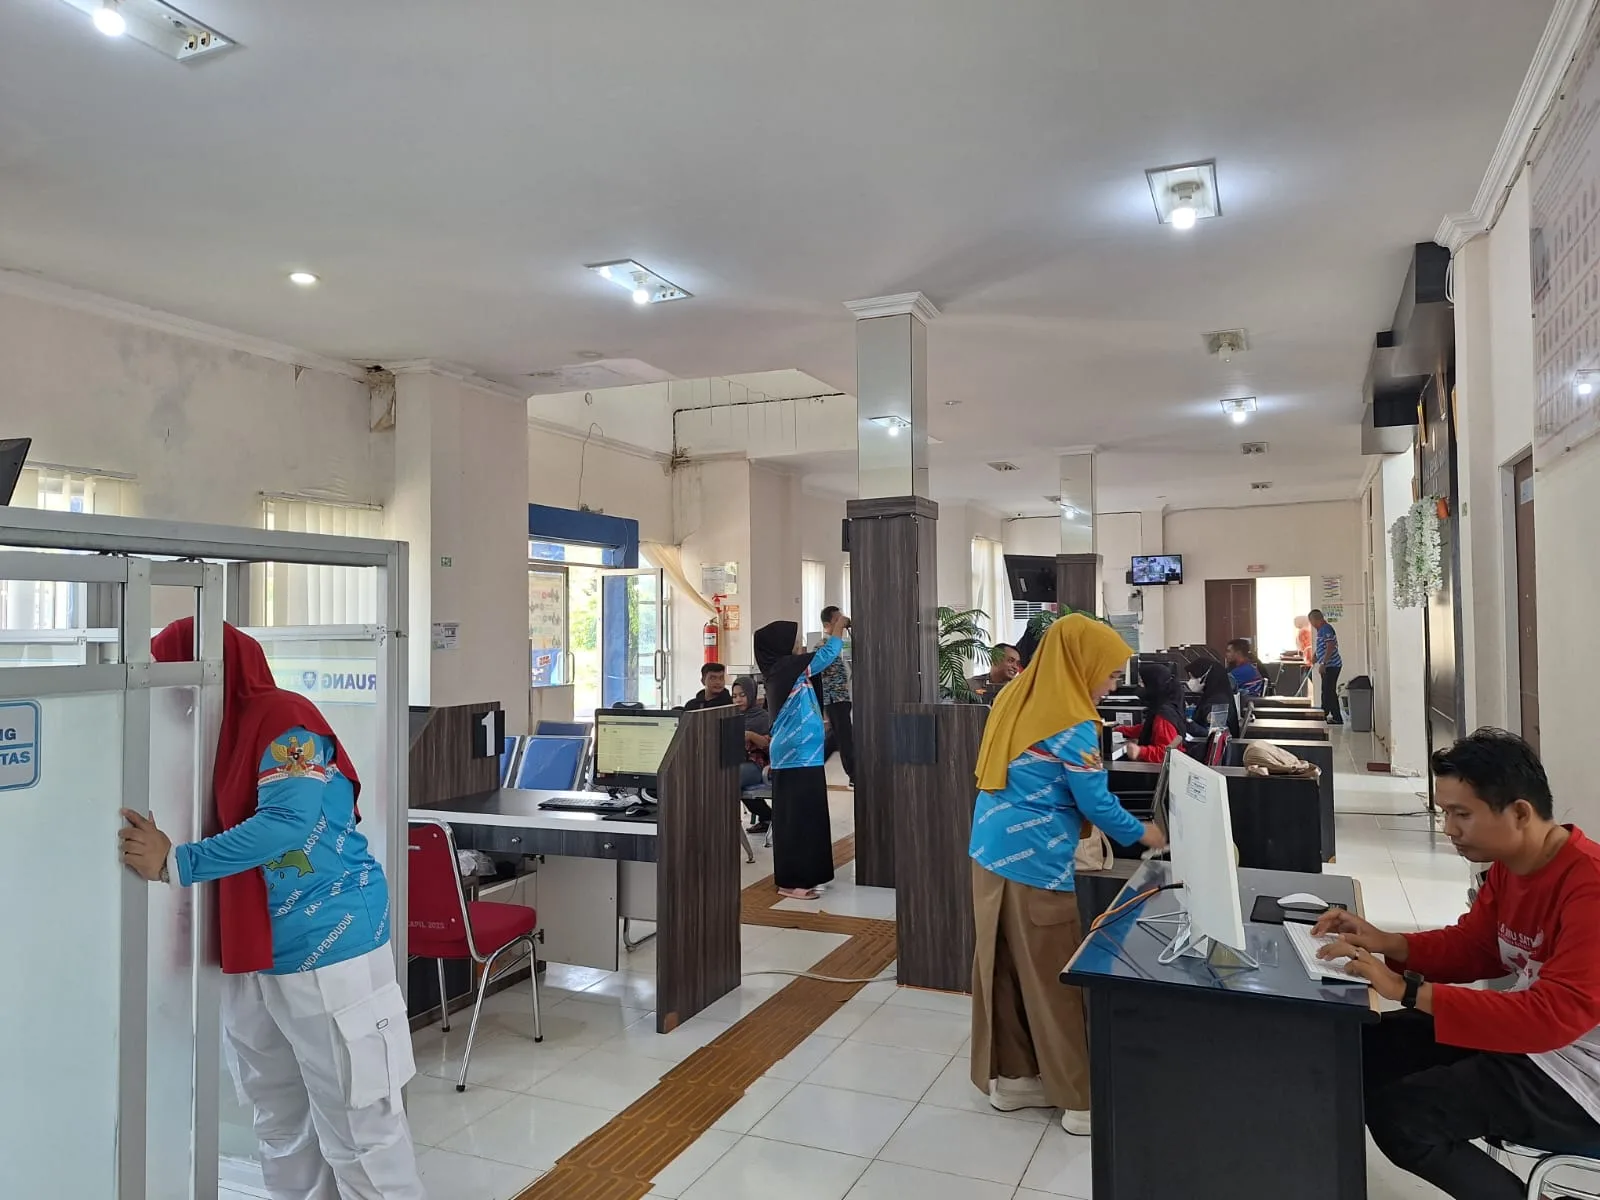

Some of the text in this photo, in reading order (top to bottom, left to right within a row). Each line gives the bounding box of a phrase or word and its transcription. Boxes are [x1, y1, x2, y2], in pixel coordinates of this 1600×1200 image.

[0, 728, 17, 742] G
[482, 711, 495, 757] 1
[302, 815, 328, 856] KAOS TAN
[316, 912, 356, 955] PENDUDUK
